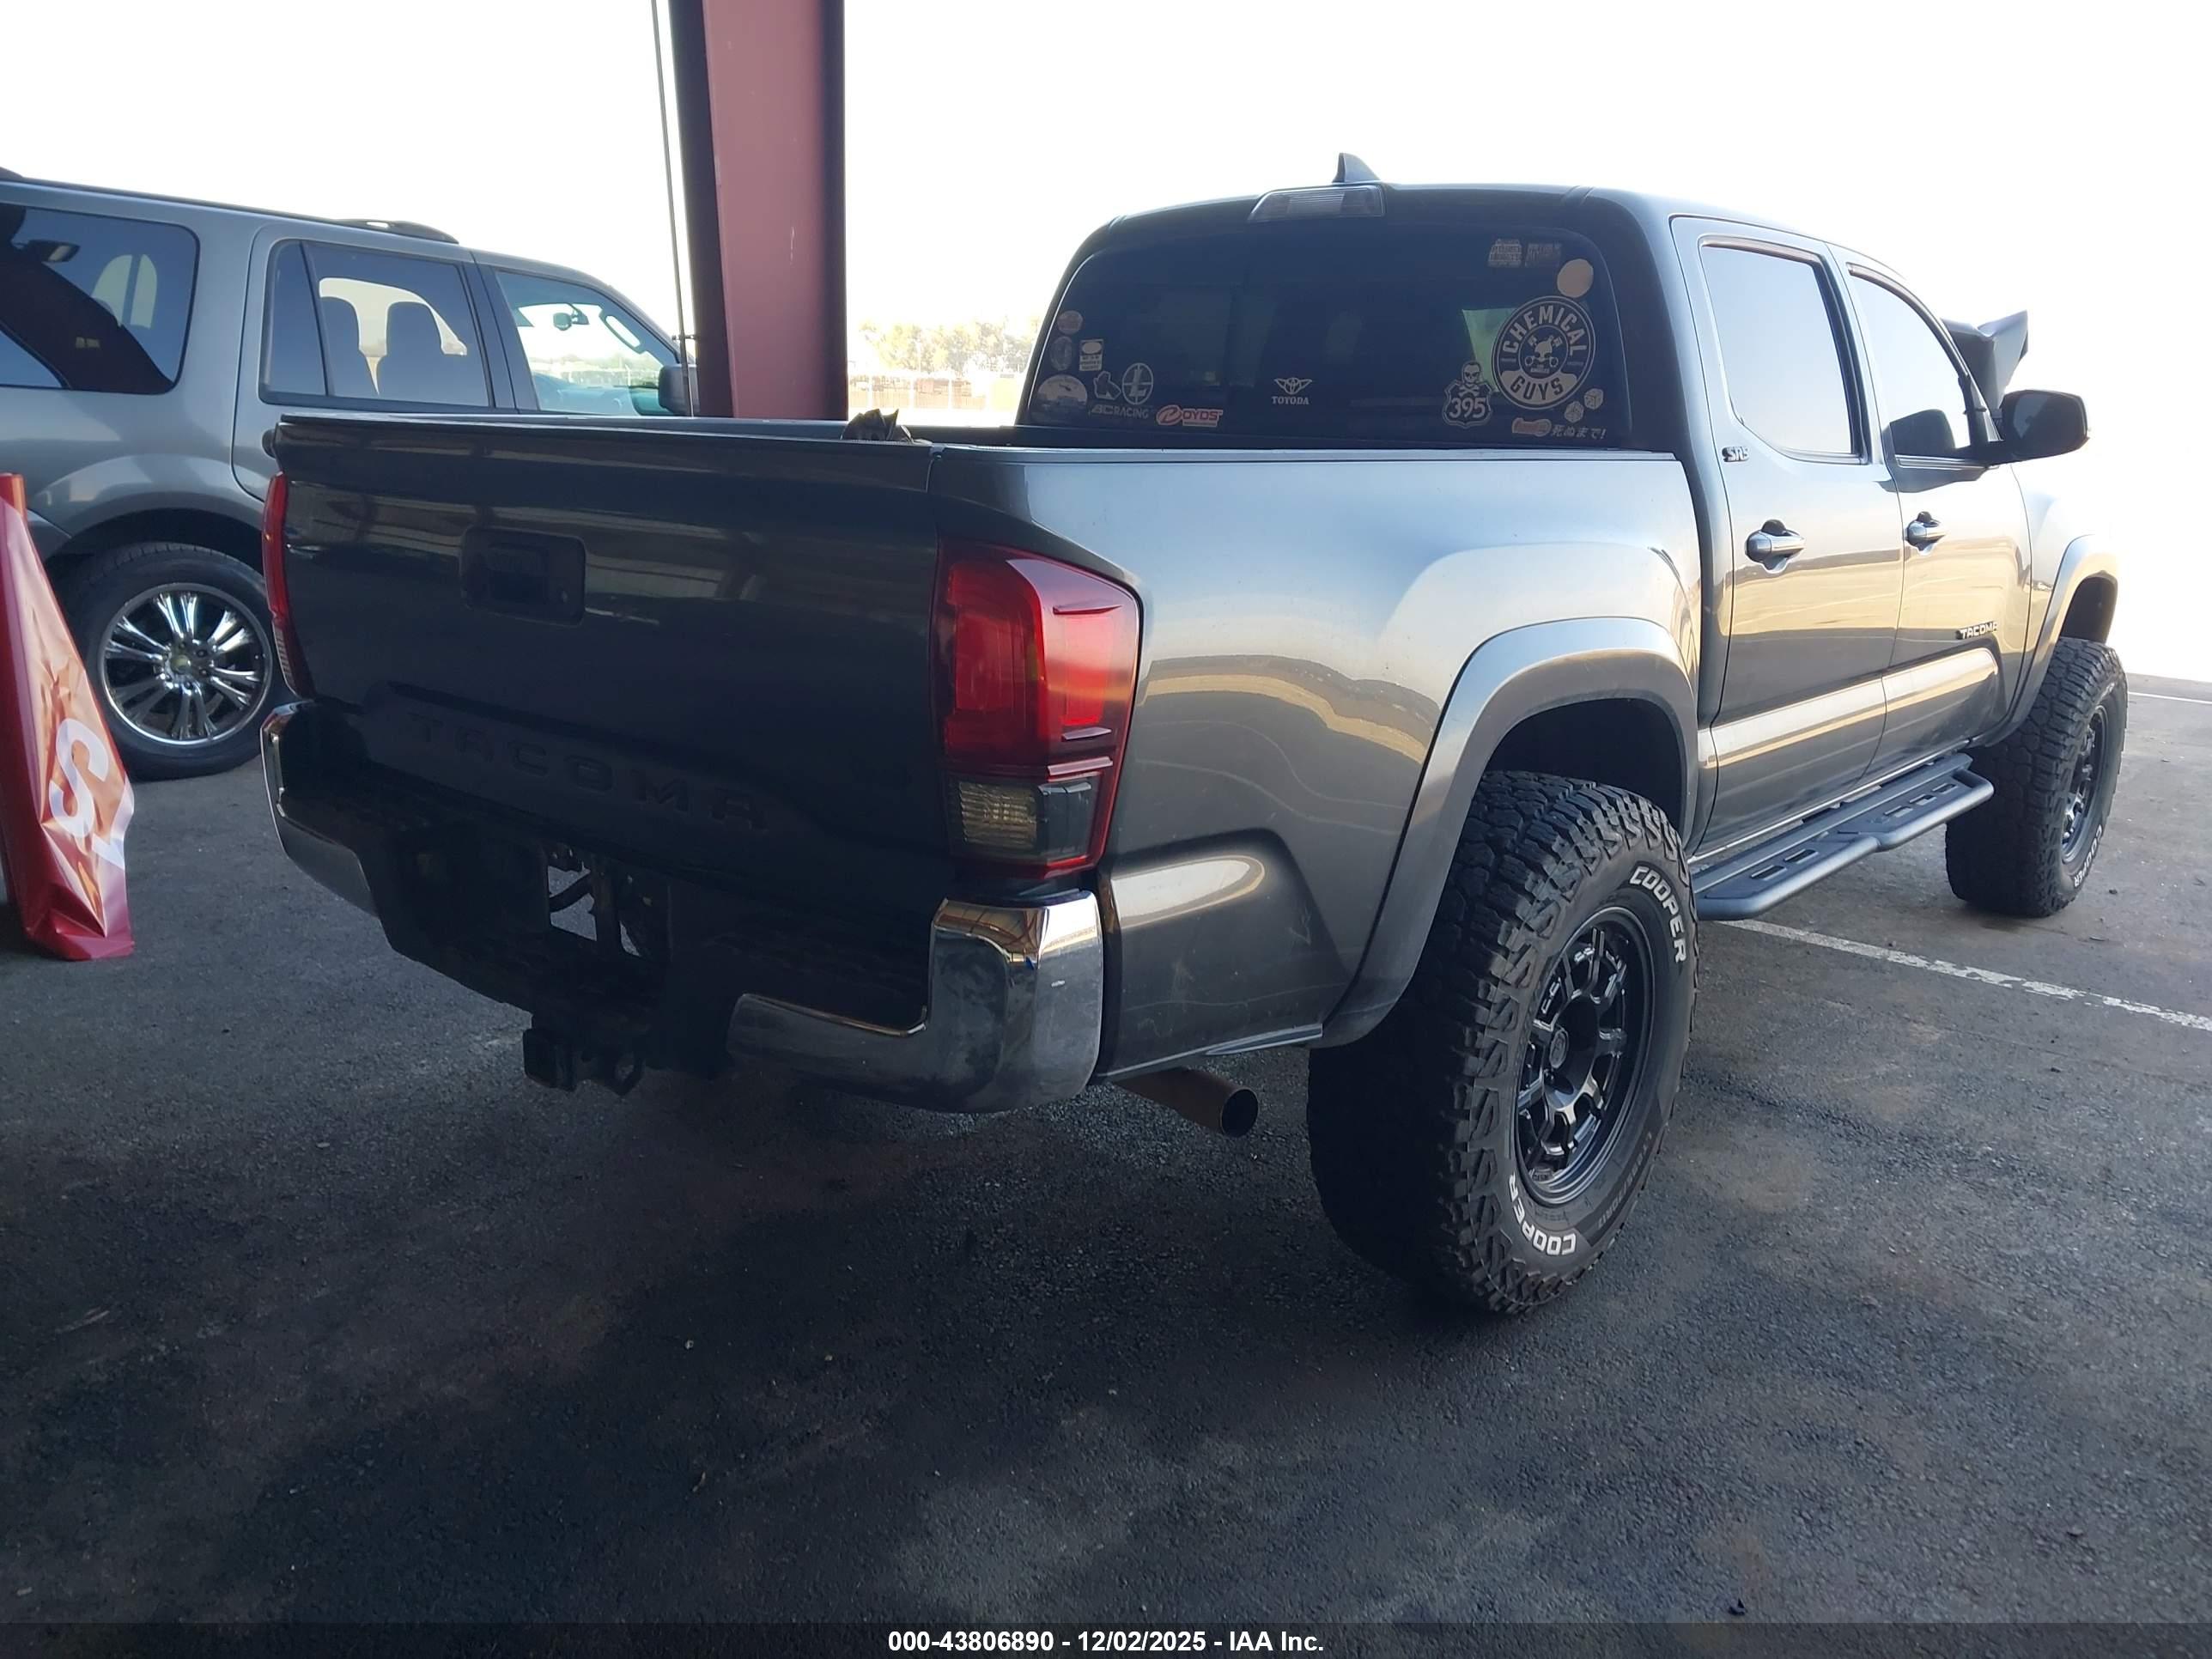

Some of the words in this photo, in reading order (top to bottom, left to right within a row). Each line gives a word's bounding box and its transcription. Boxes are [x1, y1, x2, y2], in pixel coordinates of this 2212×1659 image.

[1503, 305, 1588, 356] CHEMICAL
[1449, 398, 1486, 419] 395
[1510, 374, 1565, 400] GUYS
[1960, 621, 1998, 640] TACOMA
[407, 711, 768, 831] TACOMA
[1629, 865, 1687, 963] COOPER
[1509, 1173, 1577, 1256] COOPER
